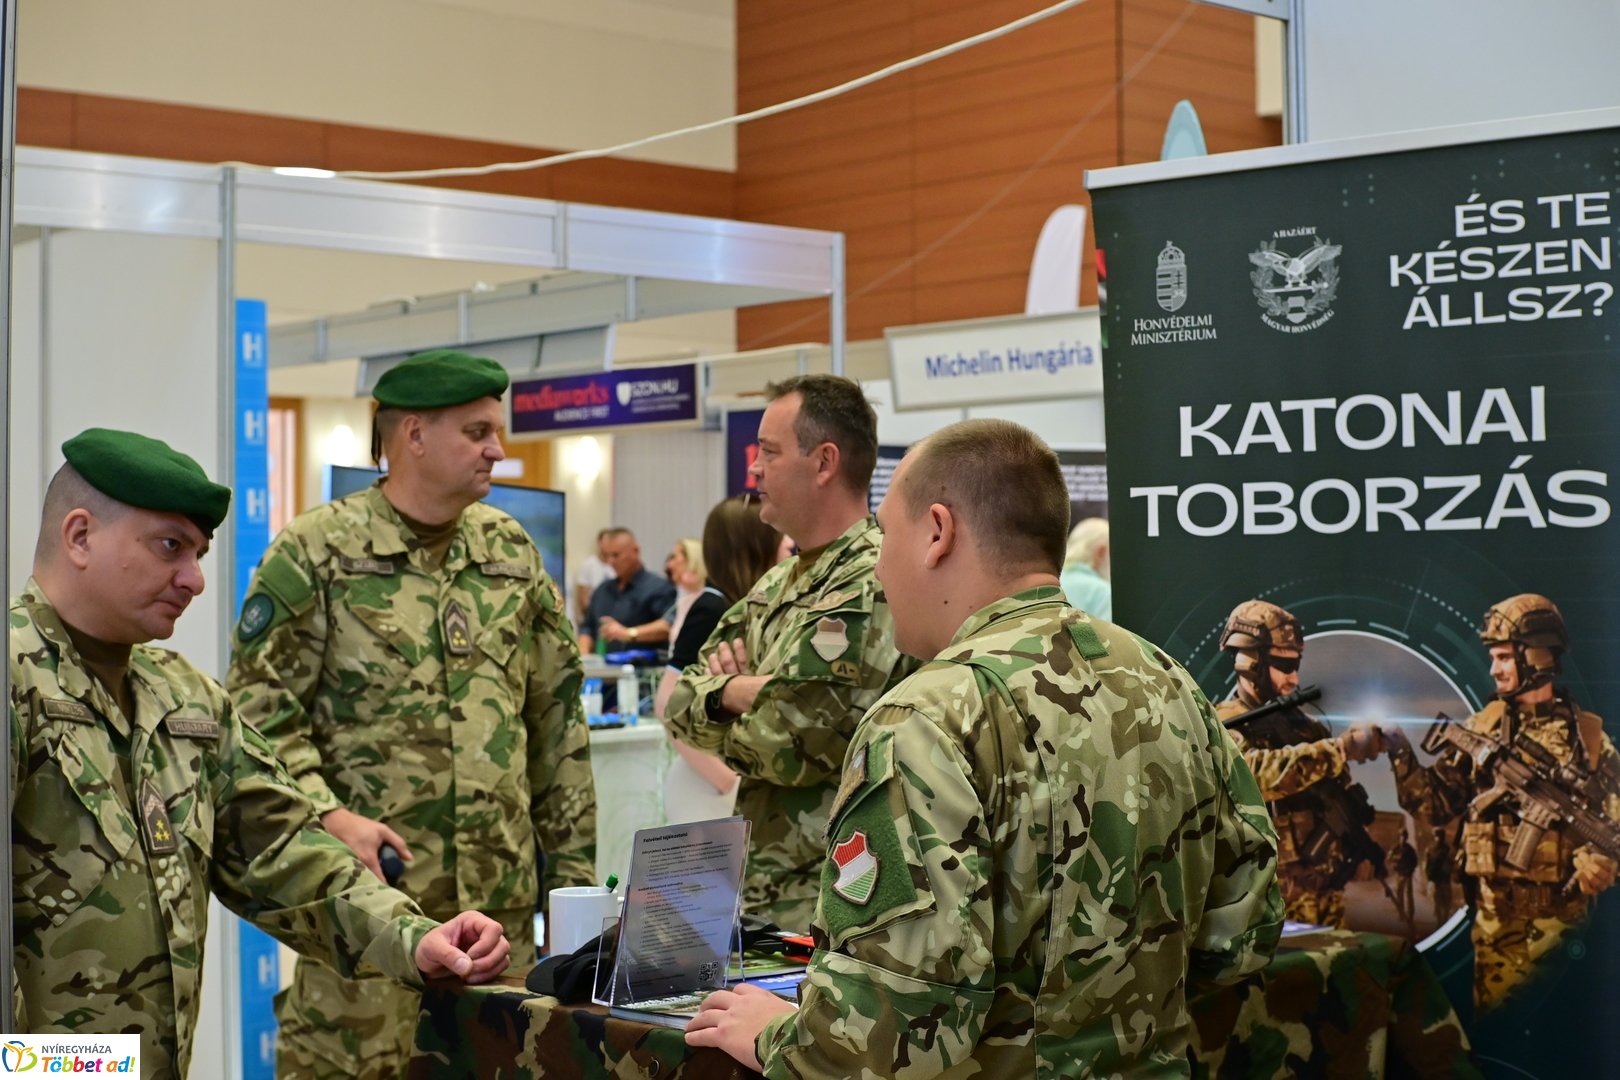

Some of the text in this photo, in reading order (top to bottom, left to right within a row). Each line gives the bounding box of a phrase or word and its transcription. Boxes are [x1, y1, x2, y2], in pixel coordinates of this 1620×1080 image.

[1273, 231, 1279, 239] A
[1455, 191, 1611, 238] ÉS TE
[1390, 237, 1612, 288] KÉSZEN
[1134, 314, 1213, 332] HONVÉDELMI
[1261, 313, 1291, 333] MAGYAR
[1402, 281, 1615, 330] ÁLLSZ?
[1131, 327, 1217, 346] MINISZTÉRIUM
[925, 341, 1094, 380] Michelin Hungária
[1179, 385, 1547, 457] KATONAI
[1130, 455, 1612, 537] TOBORZÁS
